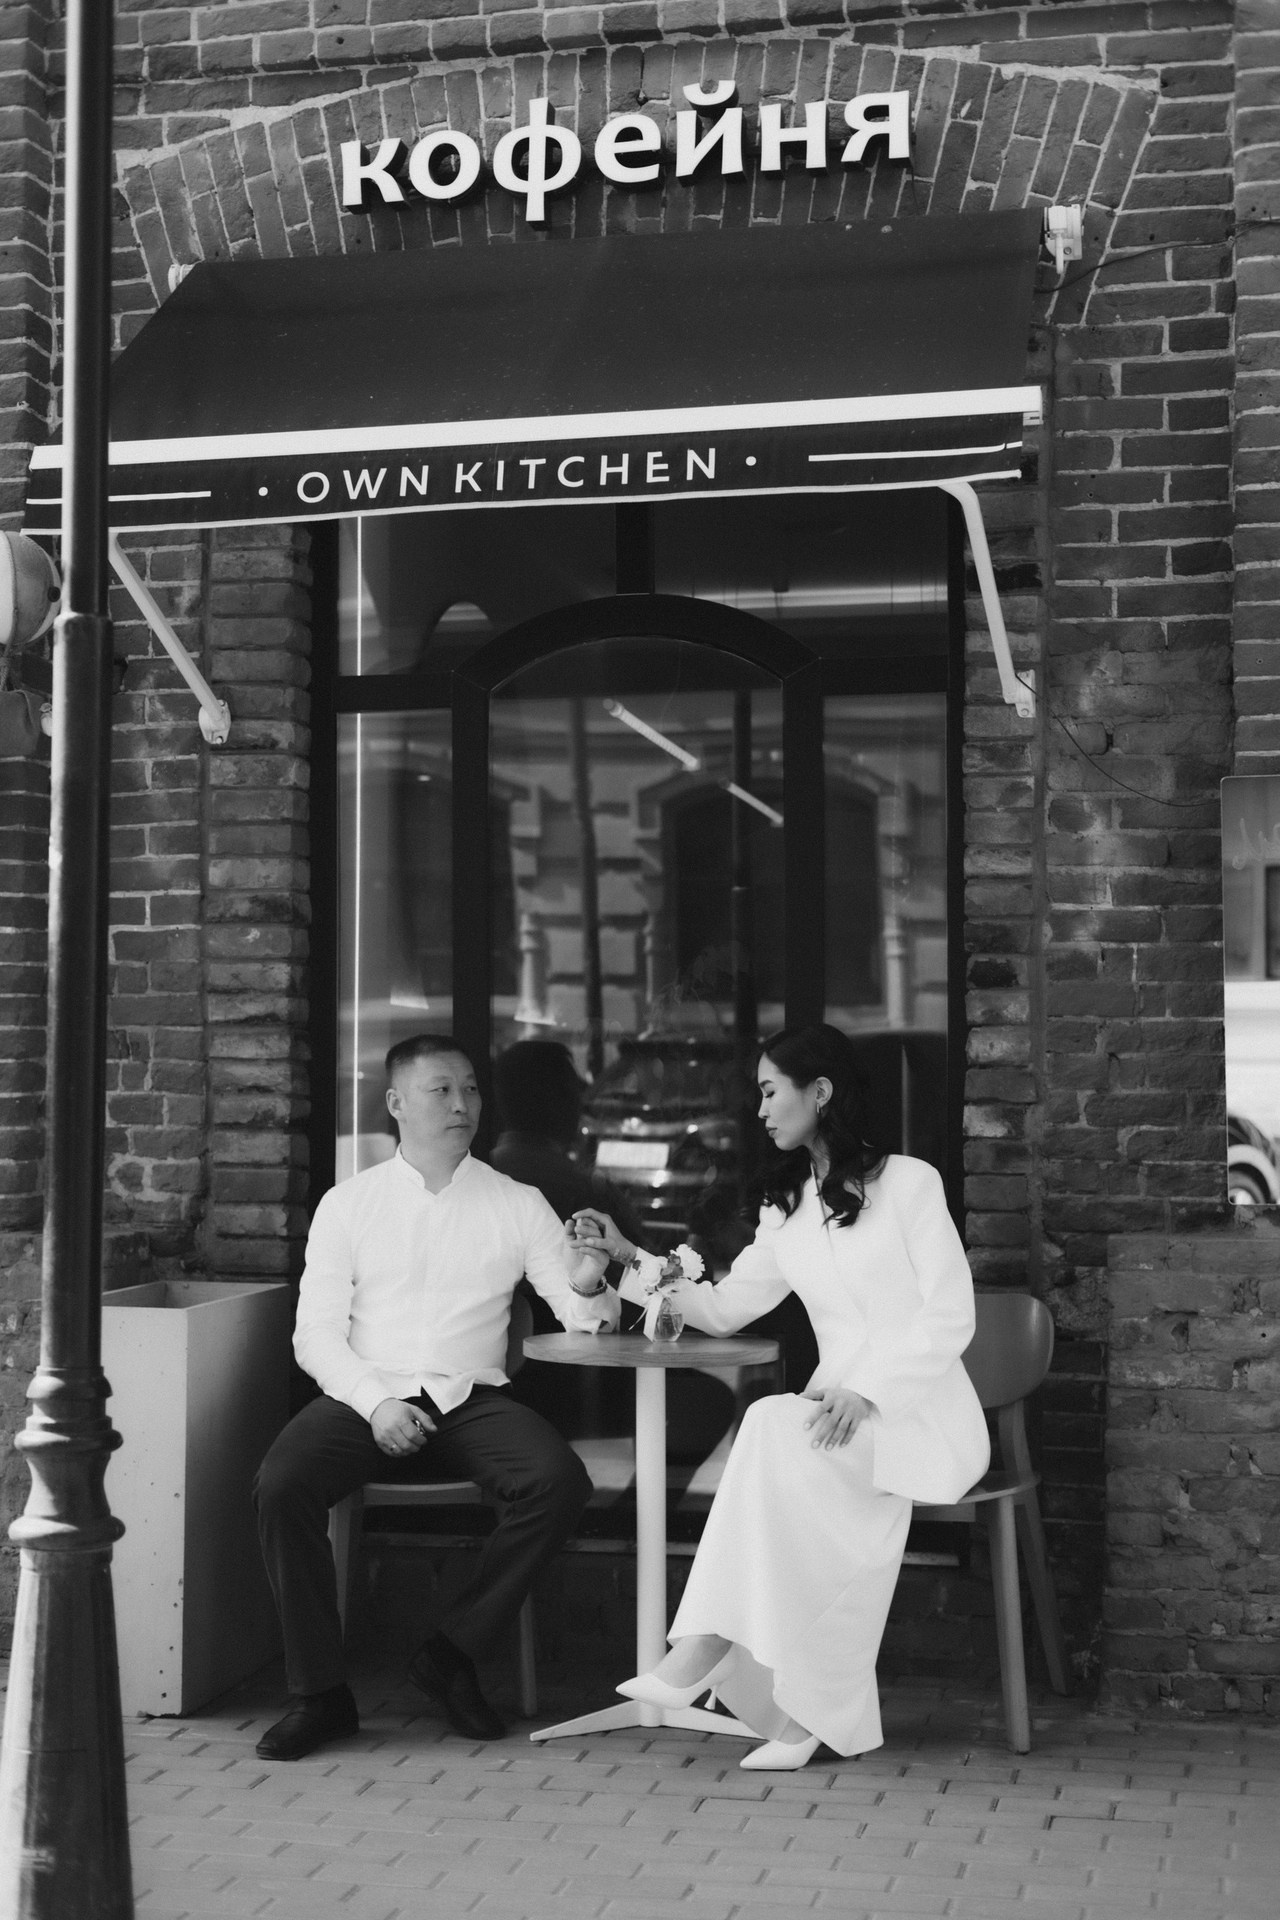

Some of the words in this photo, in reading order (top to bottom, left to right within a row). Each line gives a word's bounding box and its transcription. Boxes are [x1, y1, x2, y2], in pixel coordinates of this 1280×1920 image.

[340, 79, 911, 222] кофейня
[296, 464, 430, 504] OWN
[454, 447, 717, 493] KITCHEN
